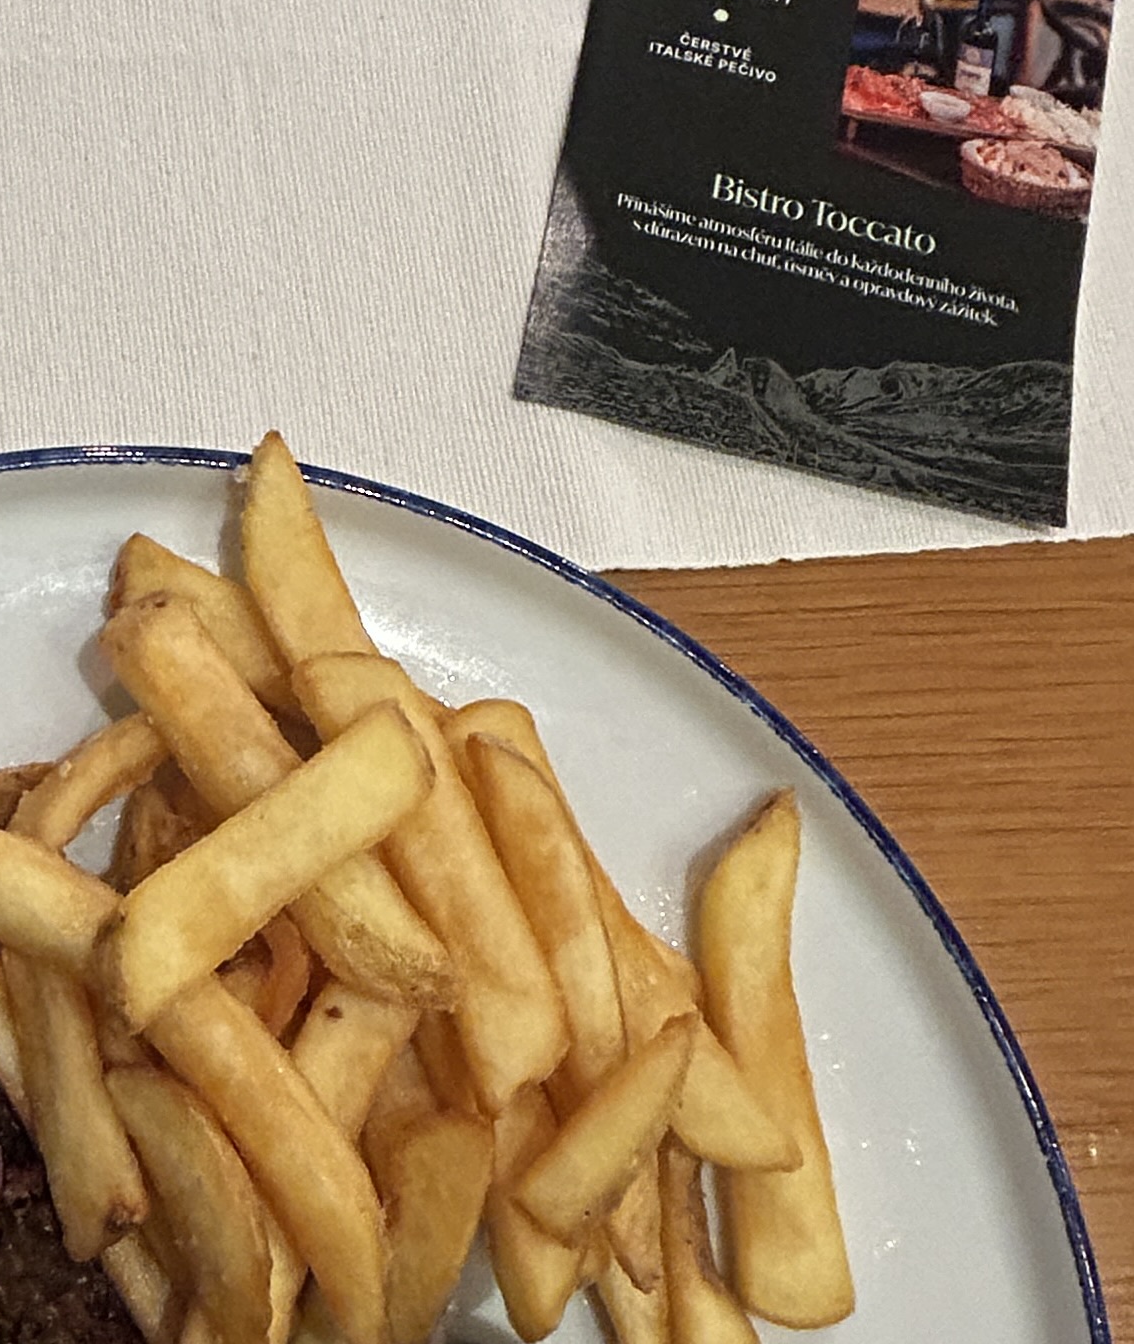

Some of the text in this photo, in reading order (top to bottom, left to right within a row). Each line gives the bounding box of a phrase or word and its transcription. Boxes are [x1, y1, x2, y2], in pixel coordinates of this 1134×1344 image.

[649, 41, 777, 82] ITALSKÉ PEČIVO
[679, 31, 752, 62] ČERSTVÉ
[617, 192, 1019, 313] Přinášíme atmosféru Itálie do každodenního života,
[712, 172, 936, 255] Bistro Toccato
[633, 220, 641, 231] s
[644, 219, 715, 251] důrazem
[718, 242, 737, 257] na
[784, 257, 839, 283] úsměv
[840, 278, 850, 288] a
[853, 279, 935, 311] opravdový
